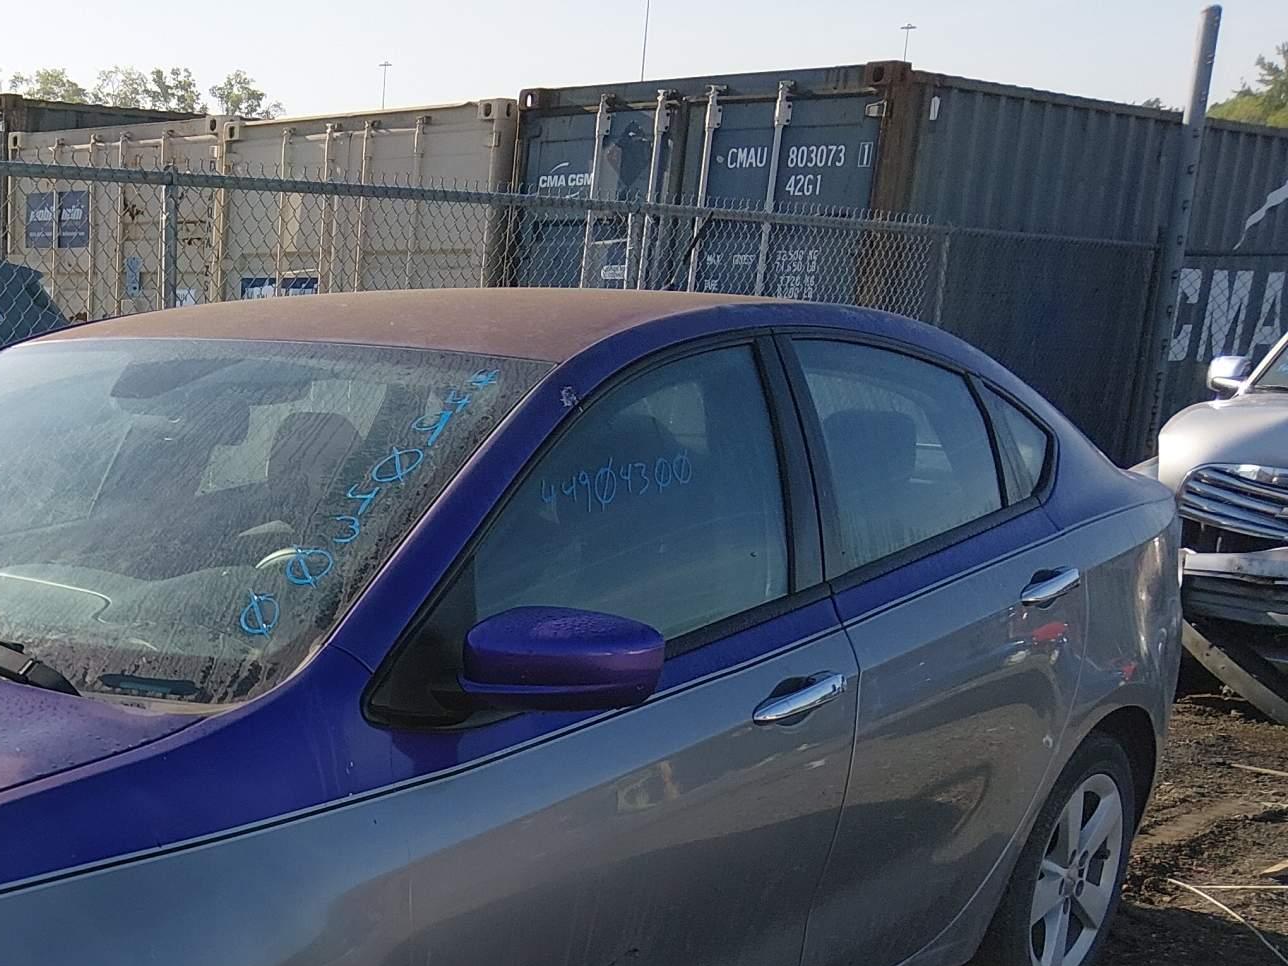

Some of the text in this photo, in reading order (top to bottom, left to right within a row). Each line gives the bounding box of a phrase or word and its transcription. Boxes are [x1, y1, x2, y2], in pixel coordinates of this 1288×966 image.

[727, 143, 872, 169] CMAU 803073 1
[539, 173, 593, 188] CMA CGM
[785, 176, 821, 196] 42G1
[540, 450, 692, 513] 44904300
